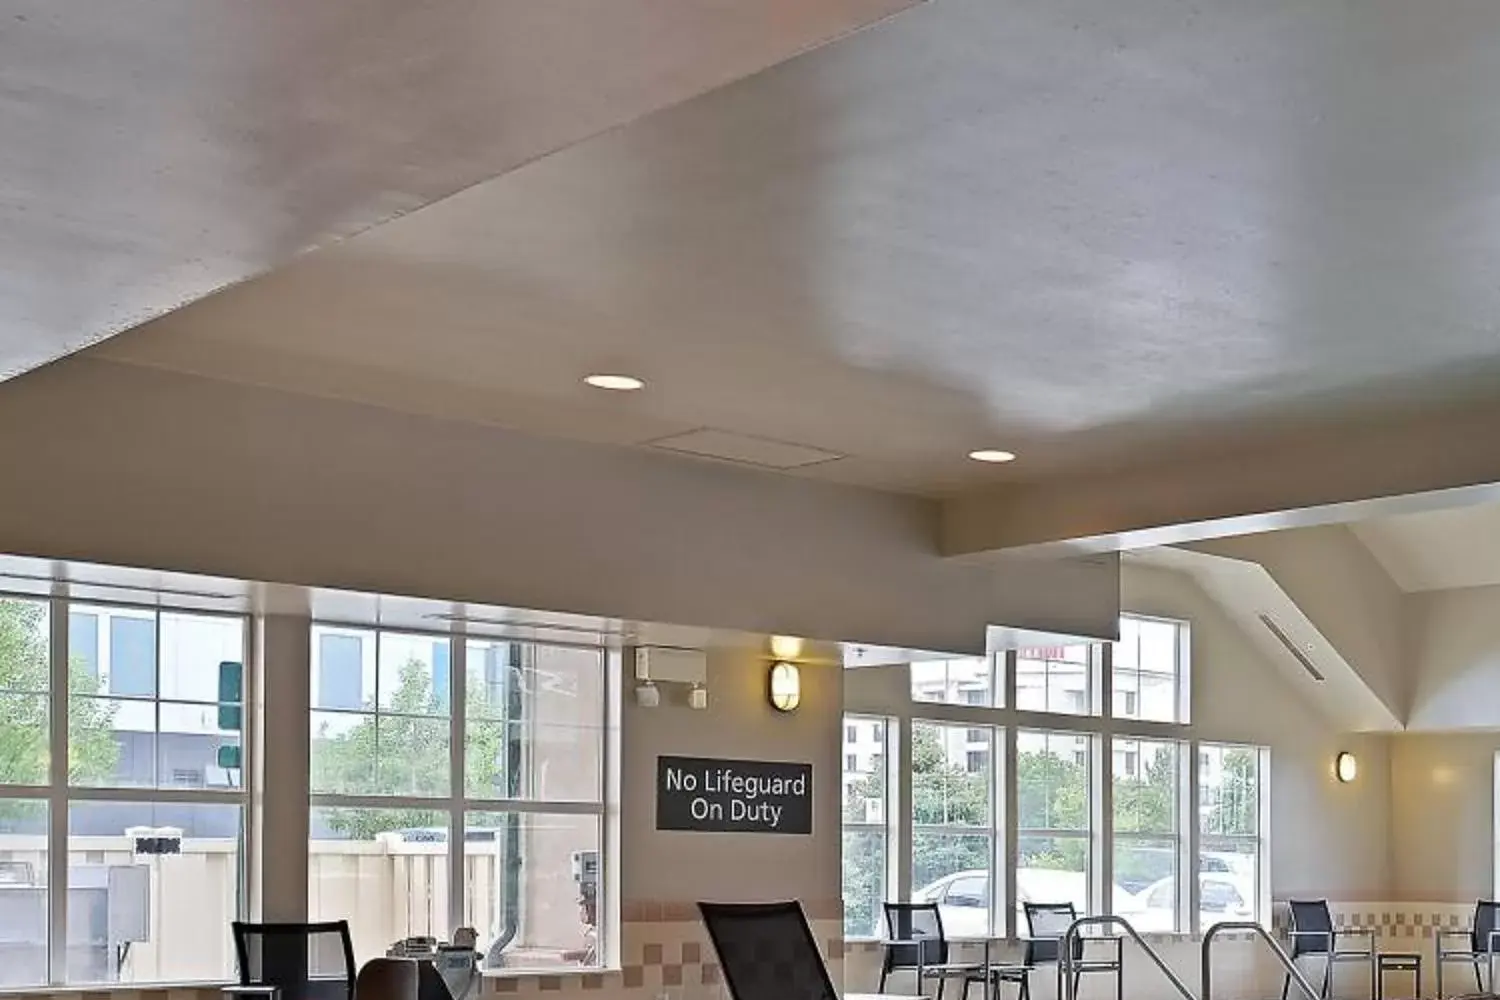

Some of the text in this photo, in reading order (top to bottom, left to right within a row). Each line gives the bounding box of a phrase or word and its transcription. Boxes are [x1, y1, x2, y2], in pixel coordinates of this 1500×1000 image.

[666, 767, 805, 799] No Lifeguard
[691, 797, 783, 827] On Duty
